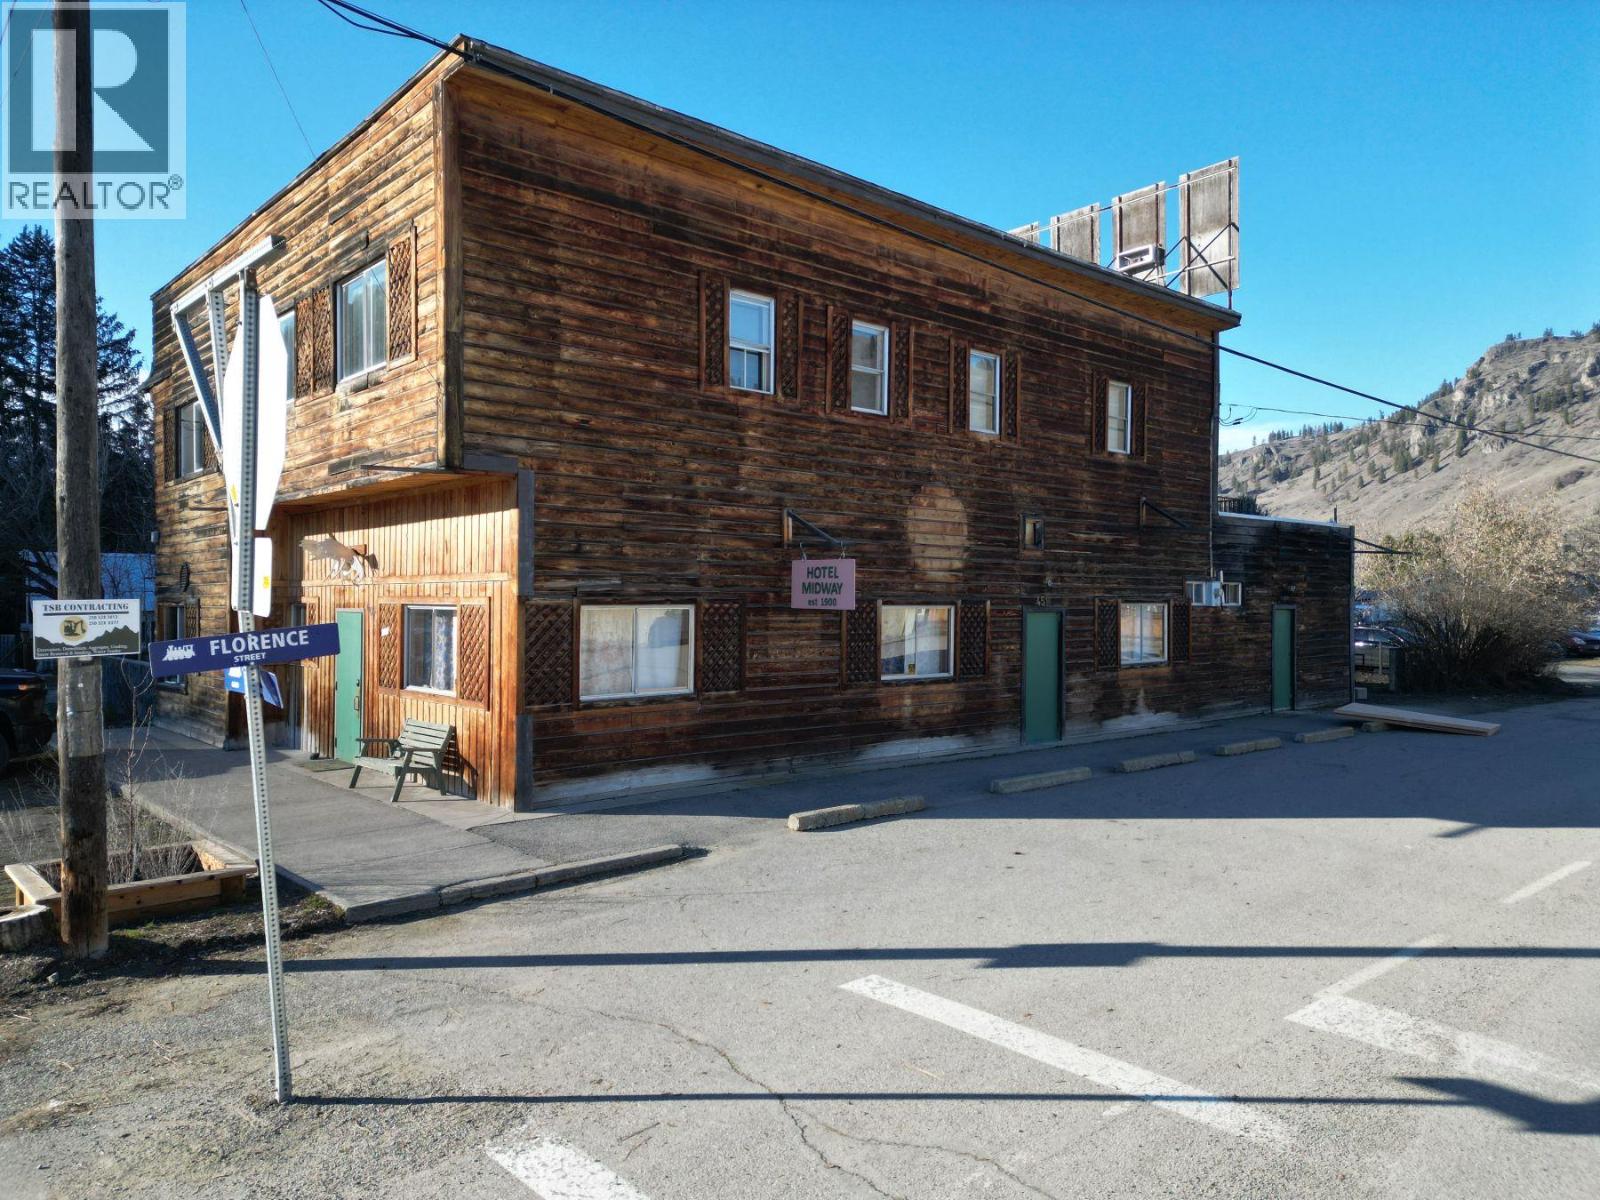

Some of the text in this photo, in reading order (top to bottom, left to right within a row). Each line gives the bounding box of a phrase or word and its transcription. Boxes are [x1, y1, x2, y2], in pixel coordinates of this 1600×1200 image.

[806, 566, 839, 579] HOTEL
[801, 582, 844, 595] MIDWAY
[43, 603, 129, 612] TSB CONTRACTING
[820, 598, 837, 607] 1900
[209, 629, 309, 656] FLORENCE
[233, 652, 267, 663] STREET
